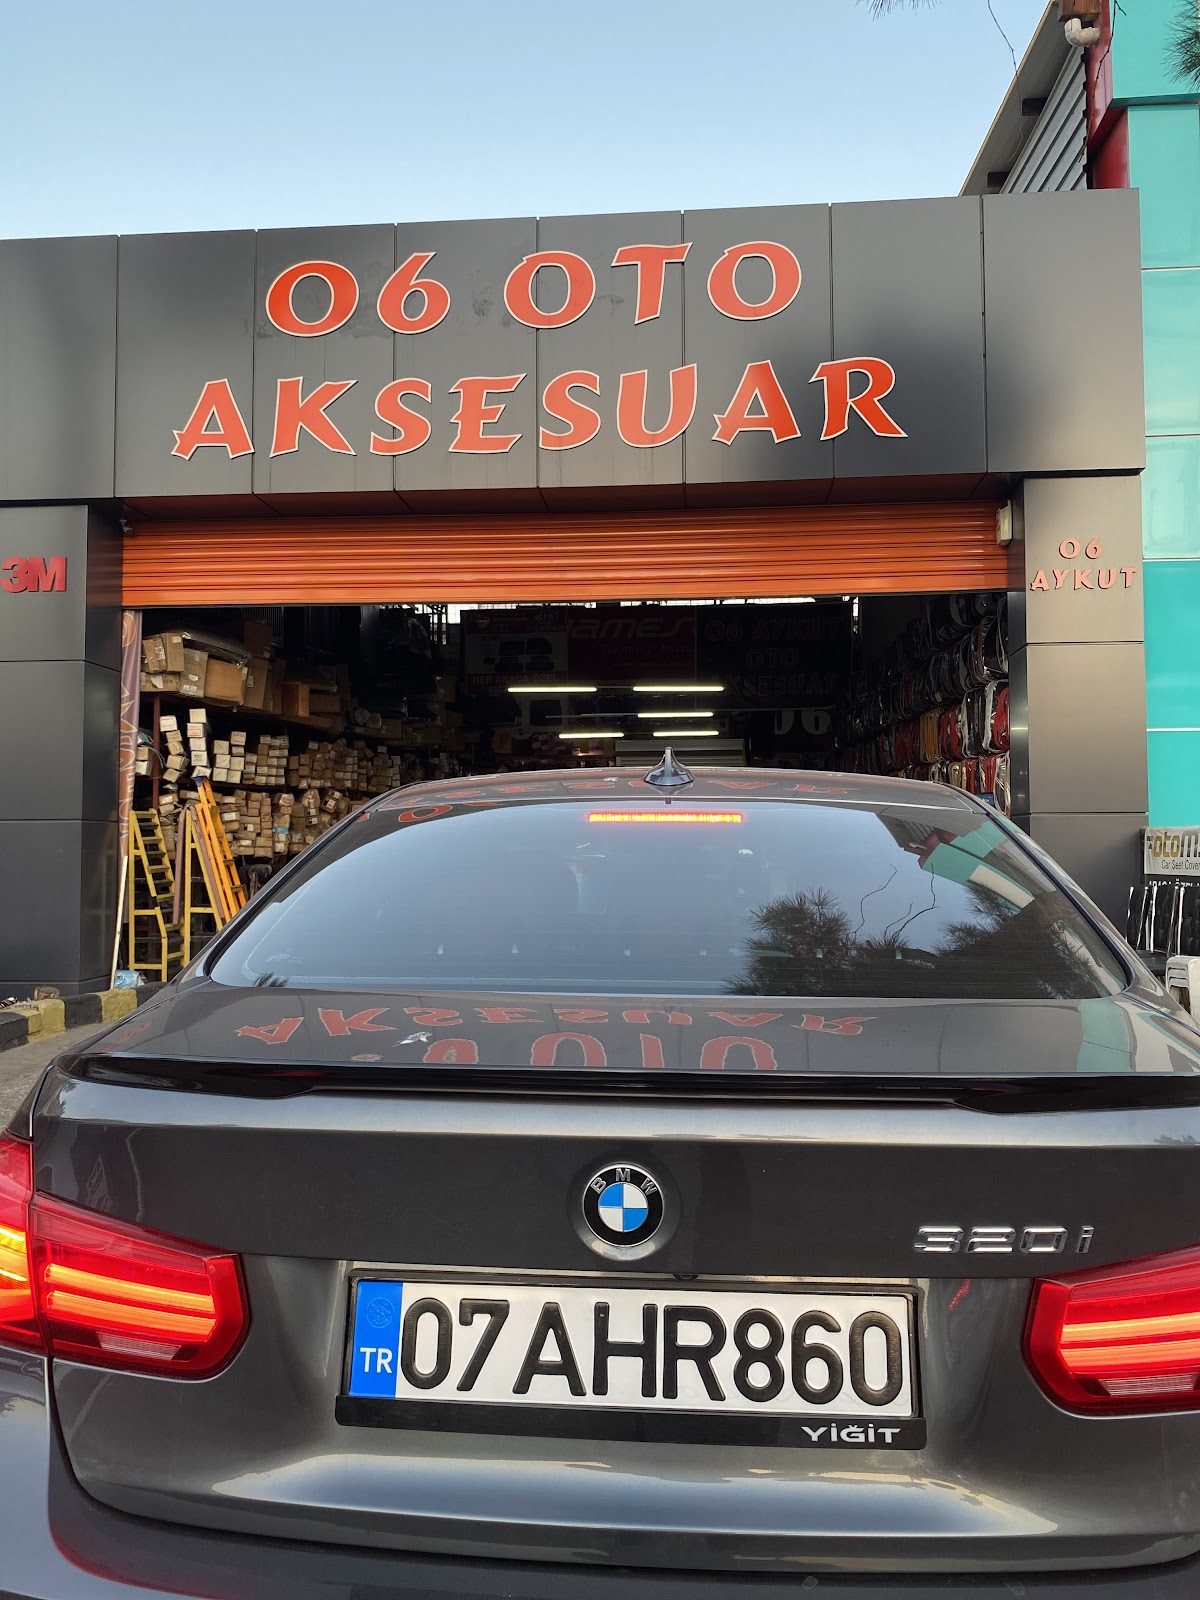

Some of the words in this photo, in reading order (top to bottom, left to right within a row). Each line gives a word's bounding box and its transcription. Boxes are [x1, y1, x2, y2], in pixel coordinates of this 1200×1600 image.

[504, 240, 802, 328] OTO
[171, 356, 908, 460] AKSESUAR
[0, 556, 67, 593] 3M
[1030, 566, 1138, 592] AYKUT
[745, 647, 800, 671] OTO
[590, 1168, 657, 1195] BMW
[914, 1225, 1095, 1254] 320i
[360, 1347, 393, 1374] TR
